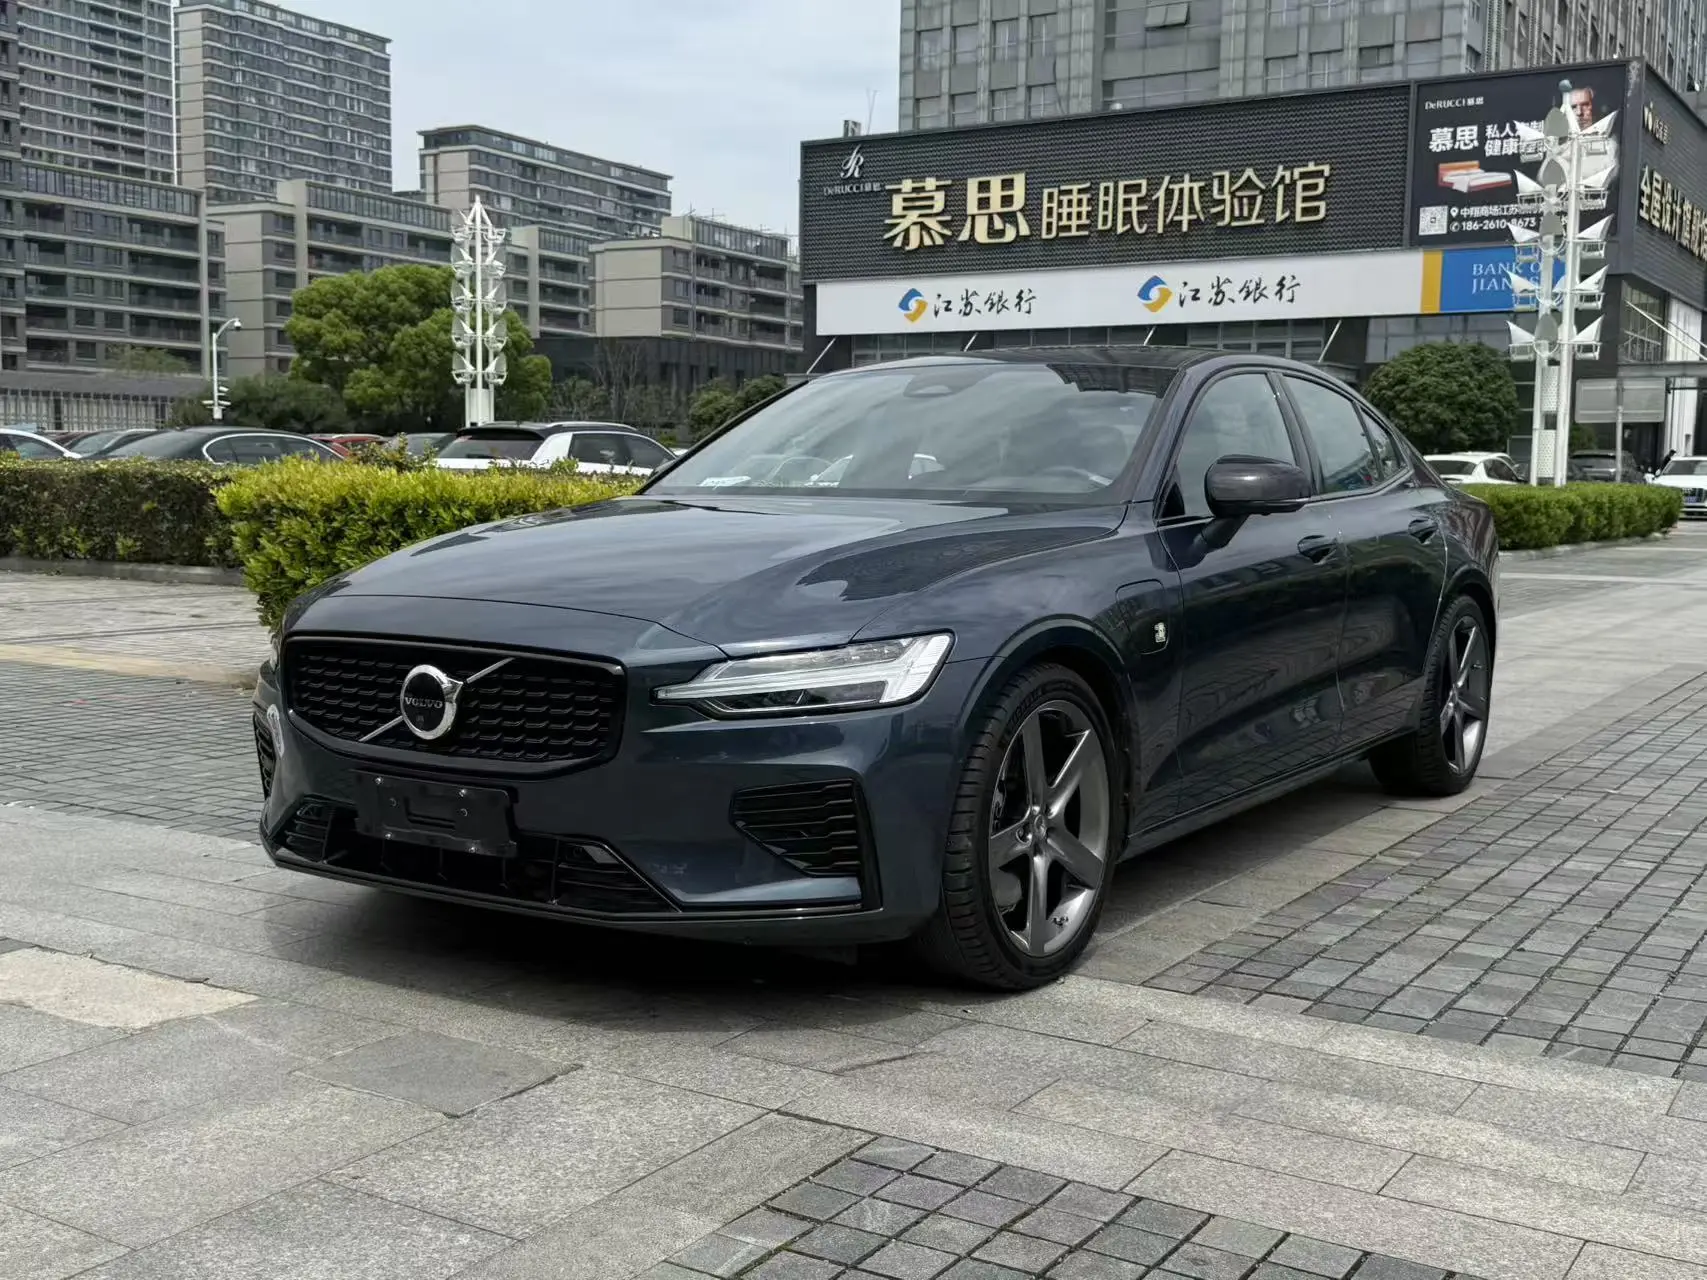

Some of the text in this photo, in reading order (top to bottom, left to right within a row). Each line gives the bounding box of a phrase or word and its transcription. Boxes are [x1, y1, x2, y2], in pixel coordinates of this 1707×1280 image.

[1425, 97, 1465, 110] DeRUCCI
[1429, 124, 1479, 153] 慕思
[1472, 262, 1522, 276] BANK
[1179, 275, 1300, 308] 江苏银行
[933, 288, 1036, 318] 江苏银行
[404, 696, 443, 709] VOLVO
